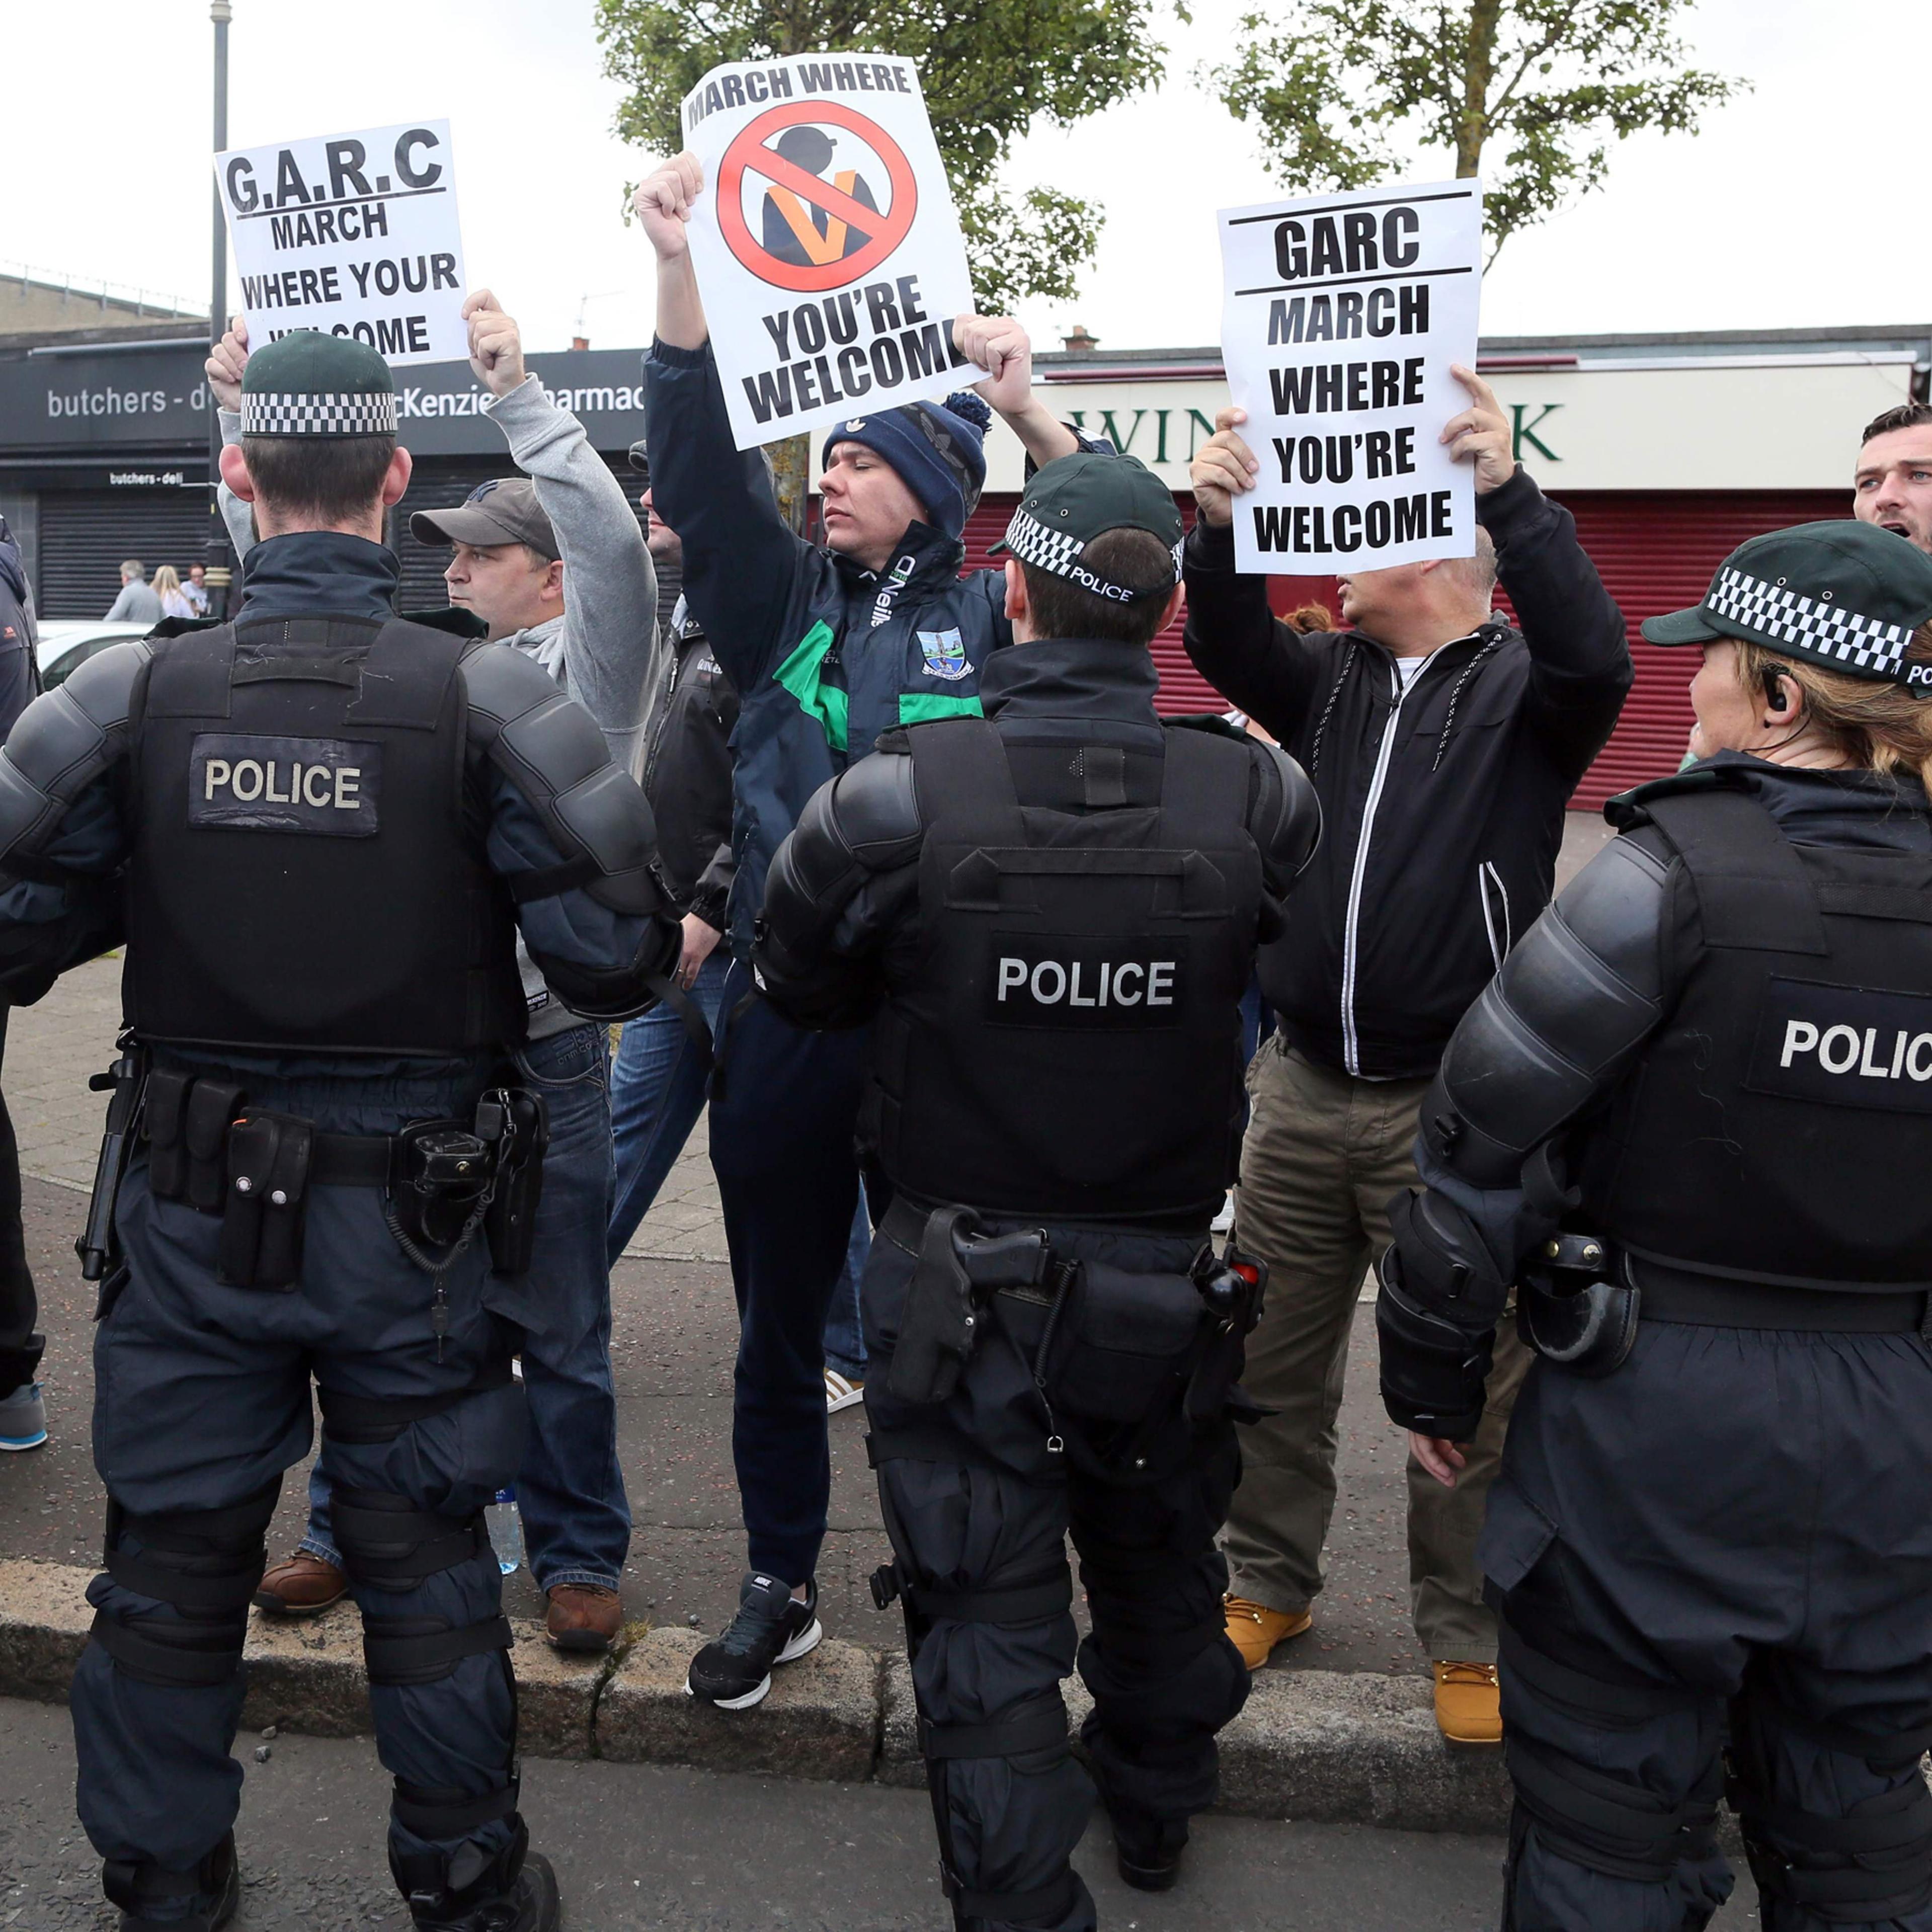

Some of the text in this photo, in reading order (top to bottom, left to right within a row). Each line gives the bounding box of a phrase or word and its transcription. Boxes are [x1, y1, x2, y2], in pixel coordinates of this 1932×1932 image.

[688, 63, 912, 132] MARCH WHERE
[226, 128, 442, 213] G.A.R.C
[270, 202, 388, 250] MARCH
[1274, 207, 1419, 280] GARC
[241, 252, 460, 310] WHERE YOUR
[762, 275, 927, 362] YOU'RE
[1267, 284, 1429, 345] MARCH
[48, 386, 167, 418] butchers
[1268, 357, 1425, 415] WHERE
[1272, 427, 1415, 484] YOU'RE
[1252, 490, 1453, 553] WELCOME
[1070, 566, 1134, 602] POLICE
[205, 759, 361, 809] POLICE
[998, 957, 1175, 1007] POLICE
